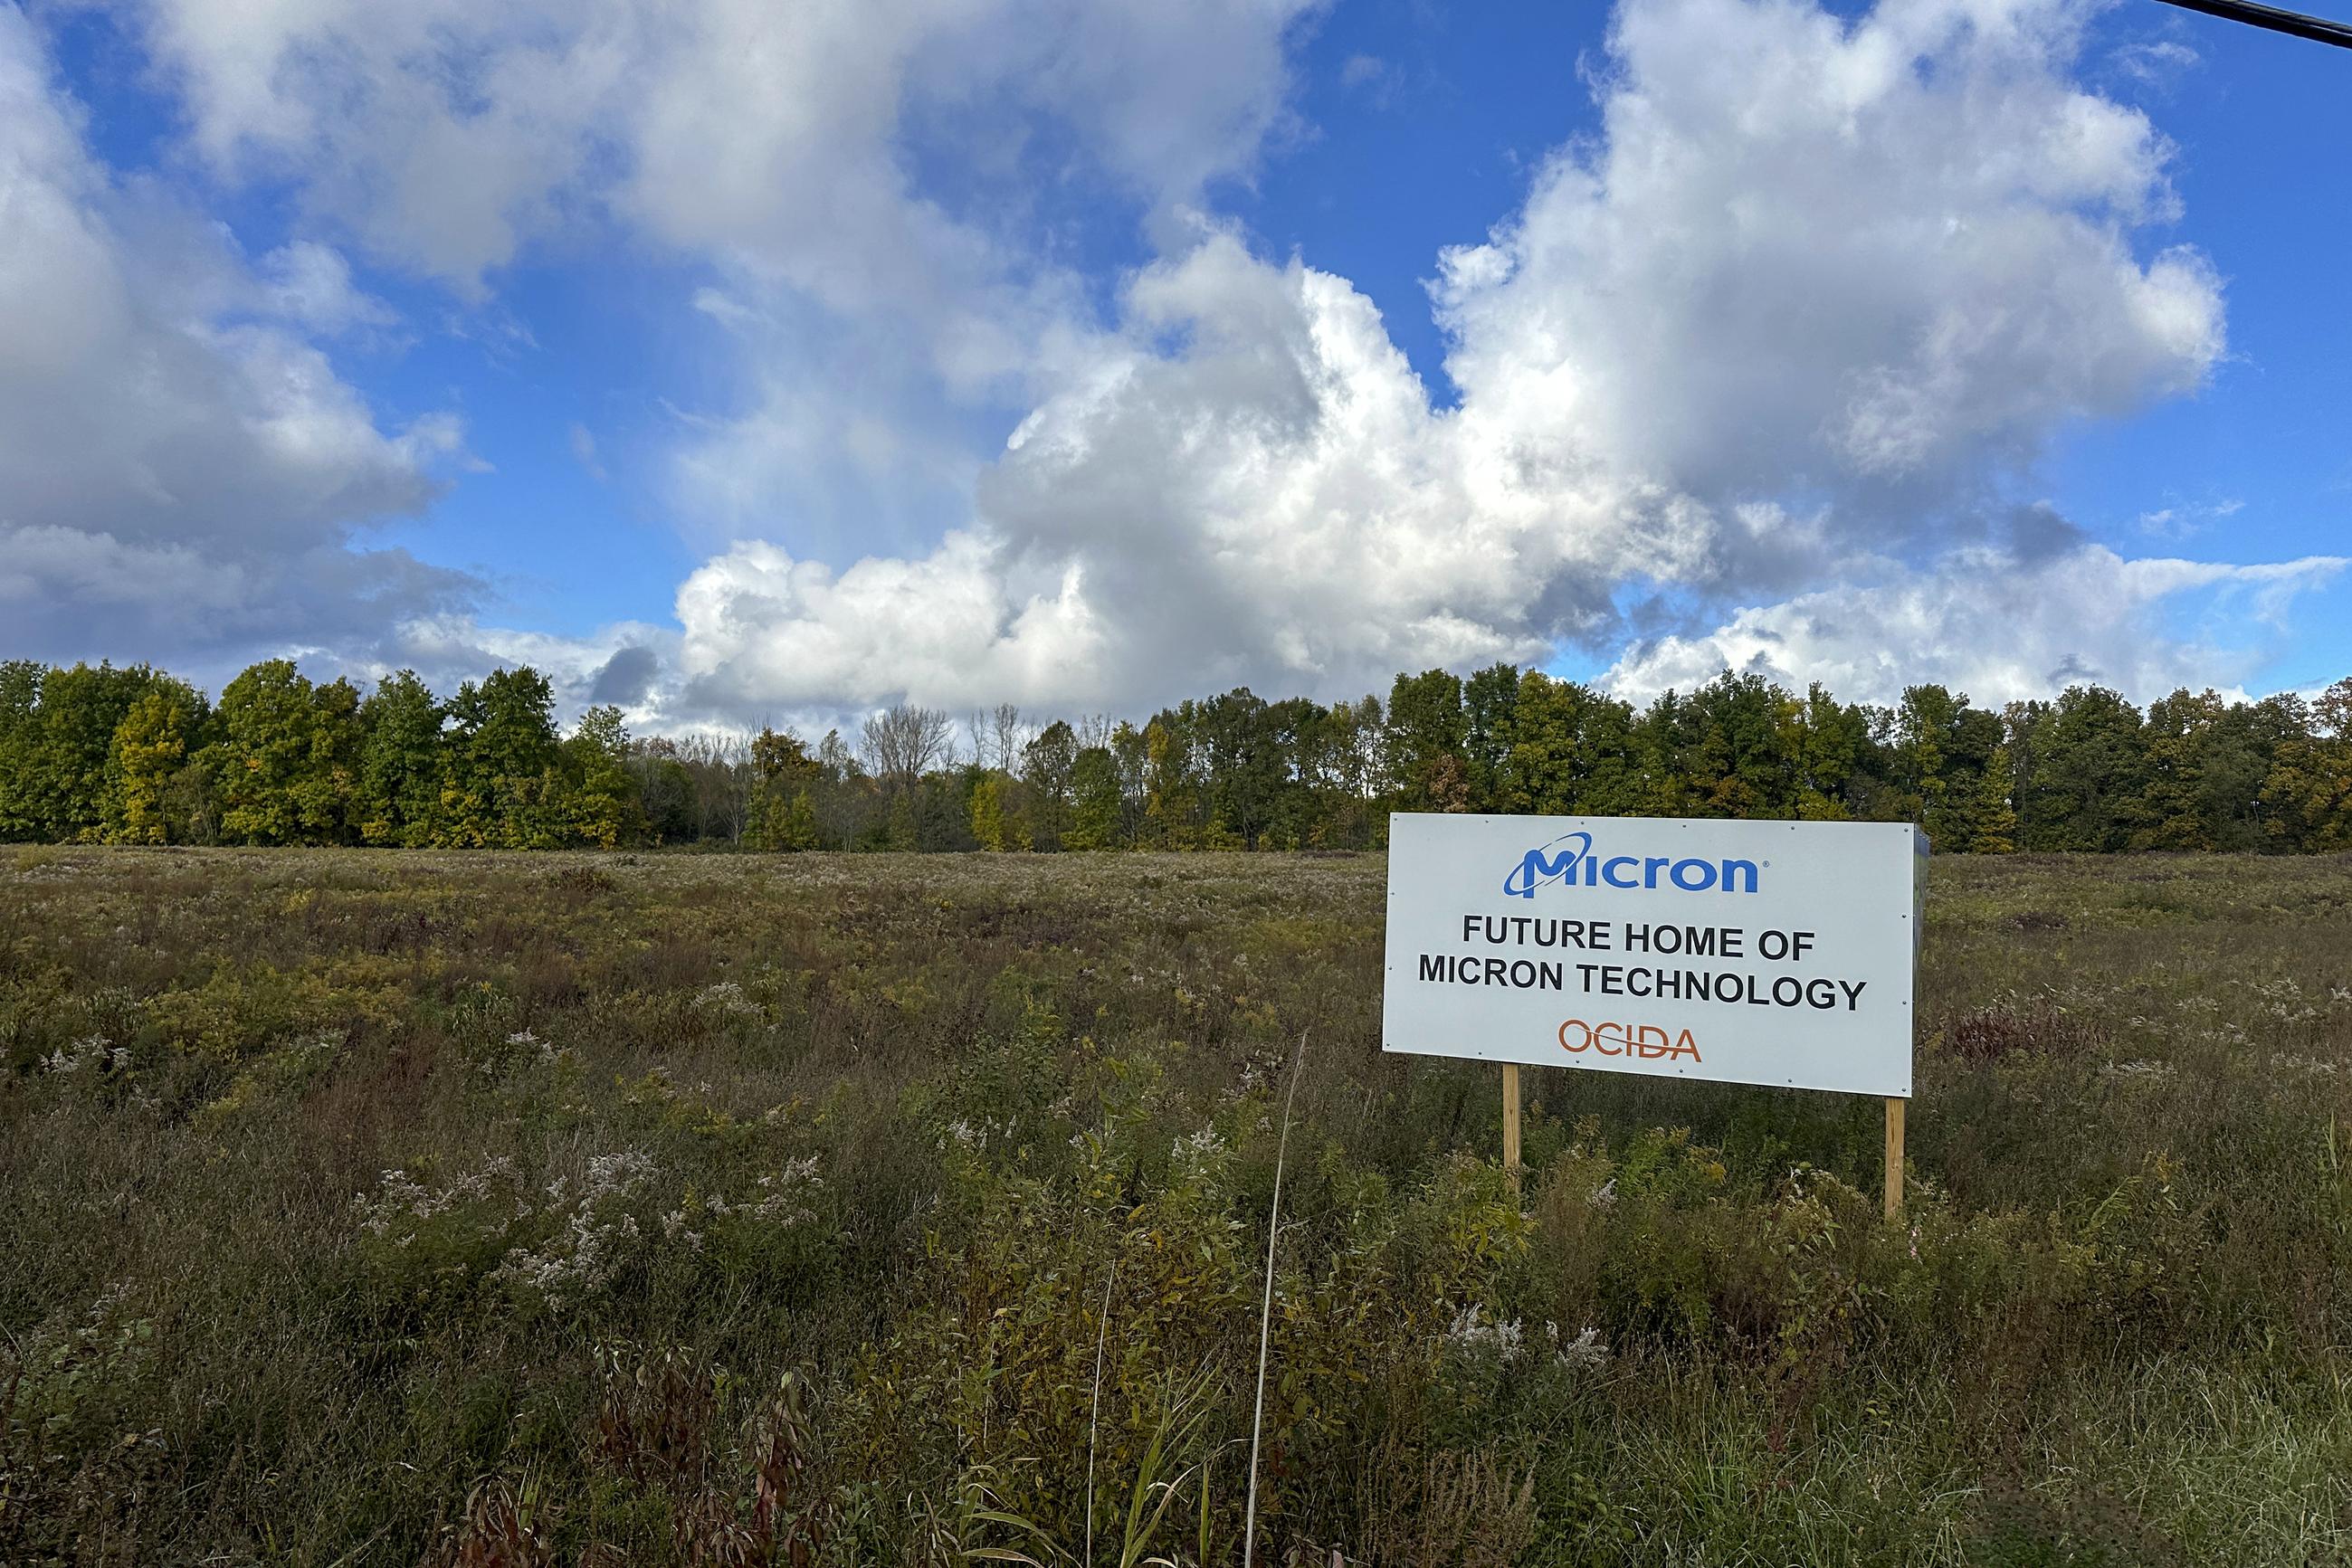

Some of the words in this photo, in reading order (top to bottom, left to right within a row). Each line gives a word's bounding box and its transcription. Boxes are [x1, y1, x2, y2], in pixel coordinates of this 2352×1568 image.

[1523, 849, 1758, 898] Micron
[1463, 915, 1611, 950] FUTURE
[1625, 923, 1744, 958] HOME
[1757, 929, 1815, 962] OF
[1419, 954, 1563, 991] MICRON
[1576, 964, 1868, 1012] TECHNOLOGY
[1558, 1019, 1702, 1063] OCIDA
